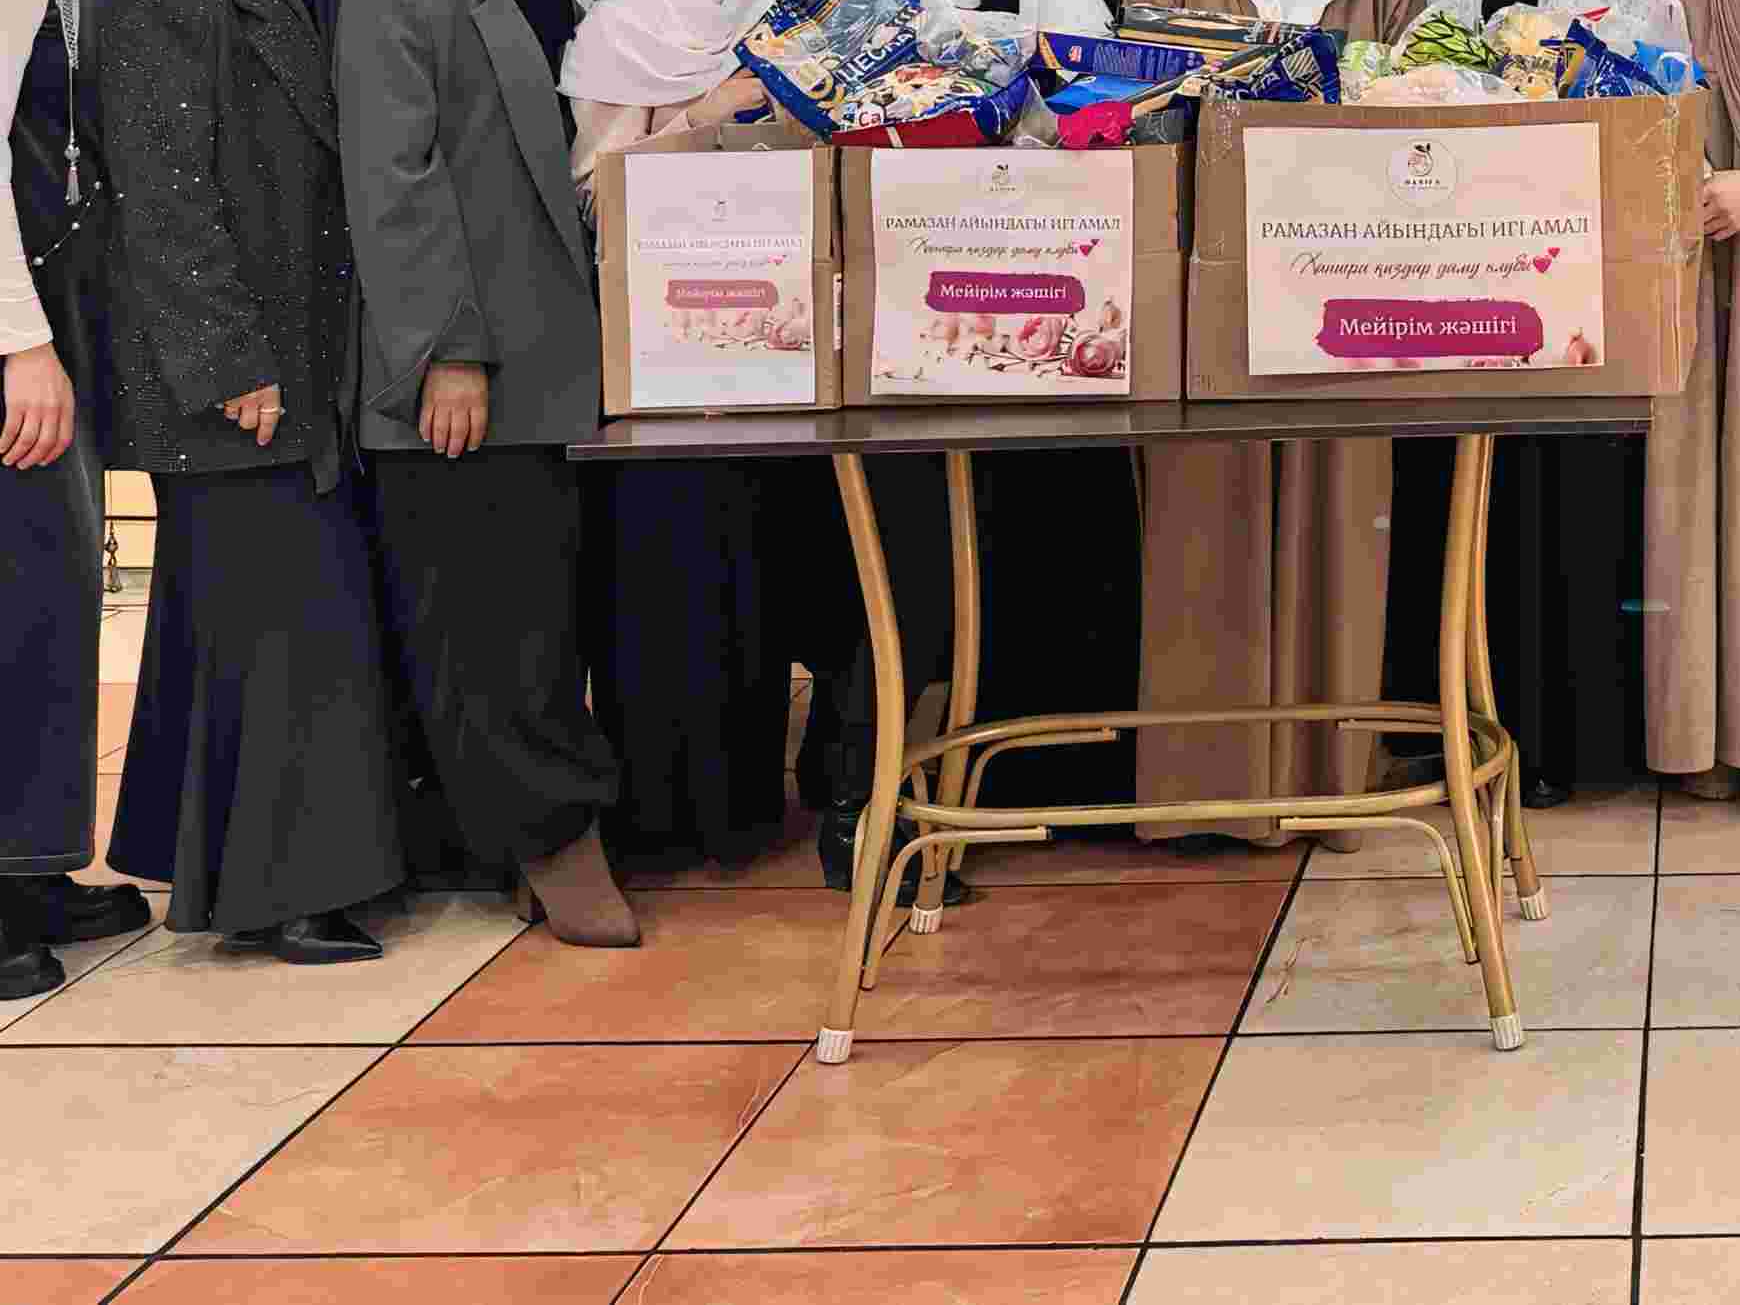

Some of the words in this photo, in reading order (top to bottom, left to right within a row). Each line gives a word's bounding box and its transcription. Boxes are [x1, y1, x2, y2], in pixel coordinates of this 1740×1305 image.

[885, 216, 956, 230] РАМАЗАН
[1261, 222, 1357, 239] РАМАЗАН
[1530, 217, 1589, 237] АМАЛ
[940, 283, 1007, 301] Мейірім
[1339, 317, 1433, 340] Мейірім
[1439, 316, 1517, 335] жәшігі
